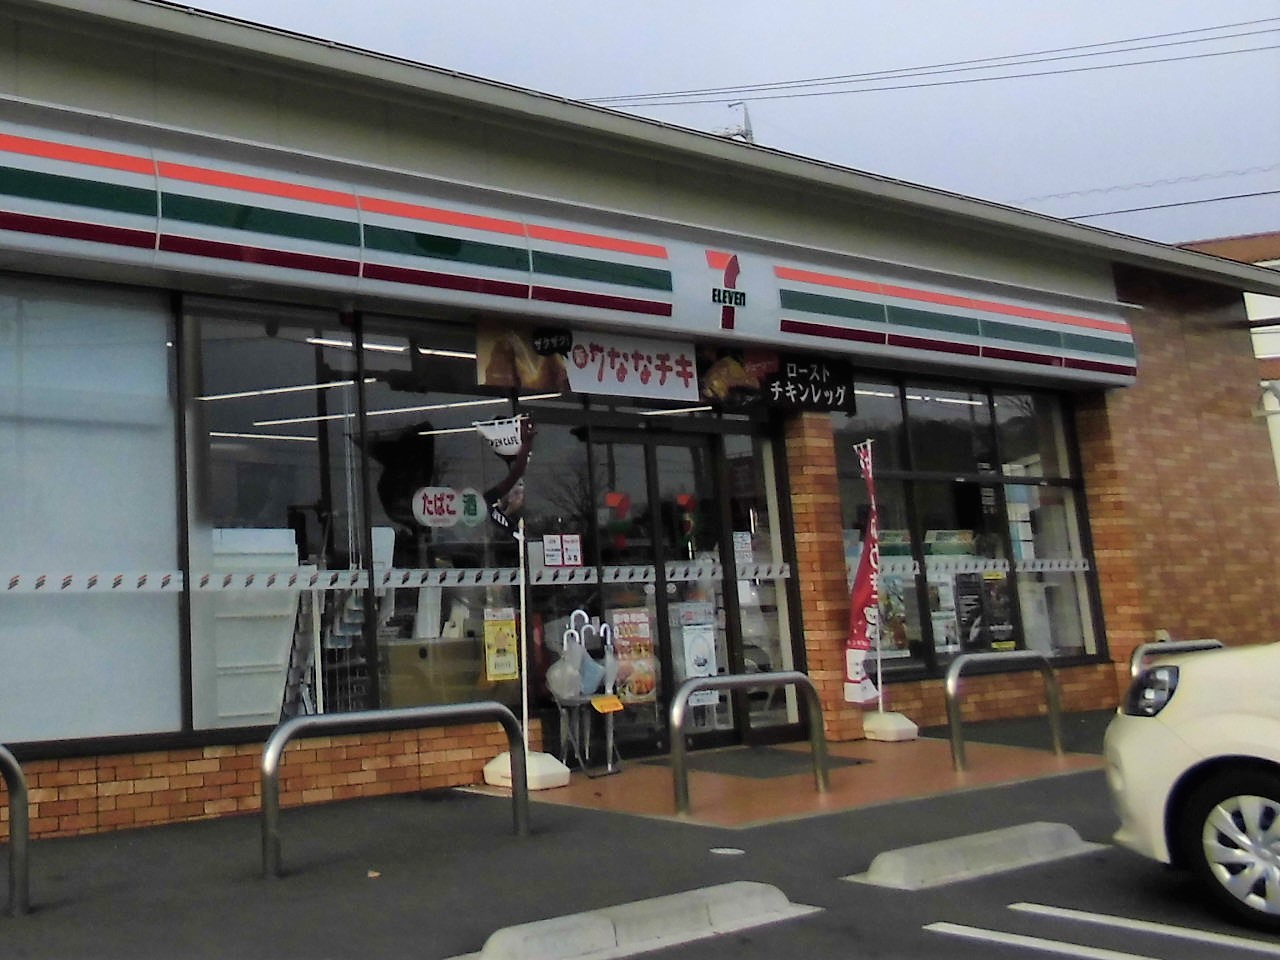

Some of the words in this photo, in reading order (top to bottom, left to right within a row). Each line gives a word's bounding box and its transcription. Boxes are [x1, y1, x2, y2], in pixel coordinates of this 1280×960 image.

[787, 363, 830, 383] ロースト
[770, 380, 846, 406] チキンレッグ
[422, 493, 457, 517] たばこ
[463, 493, 478, 517] 酒
